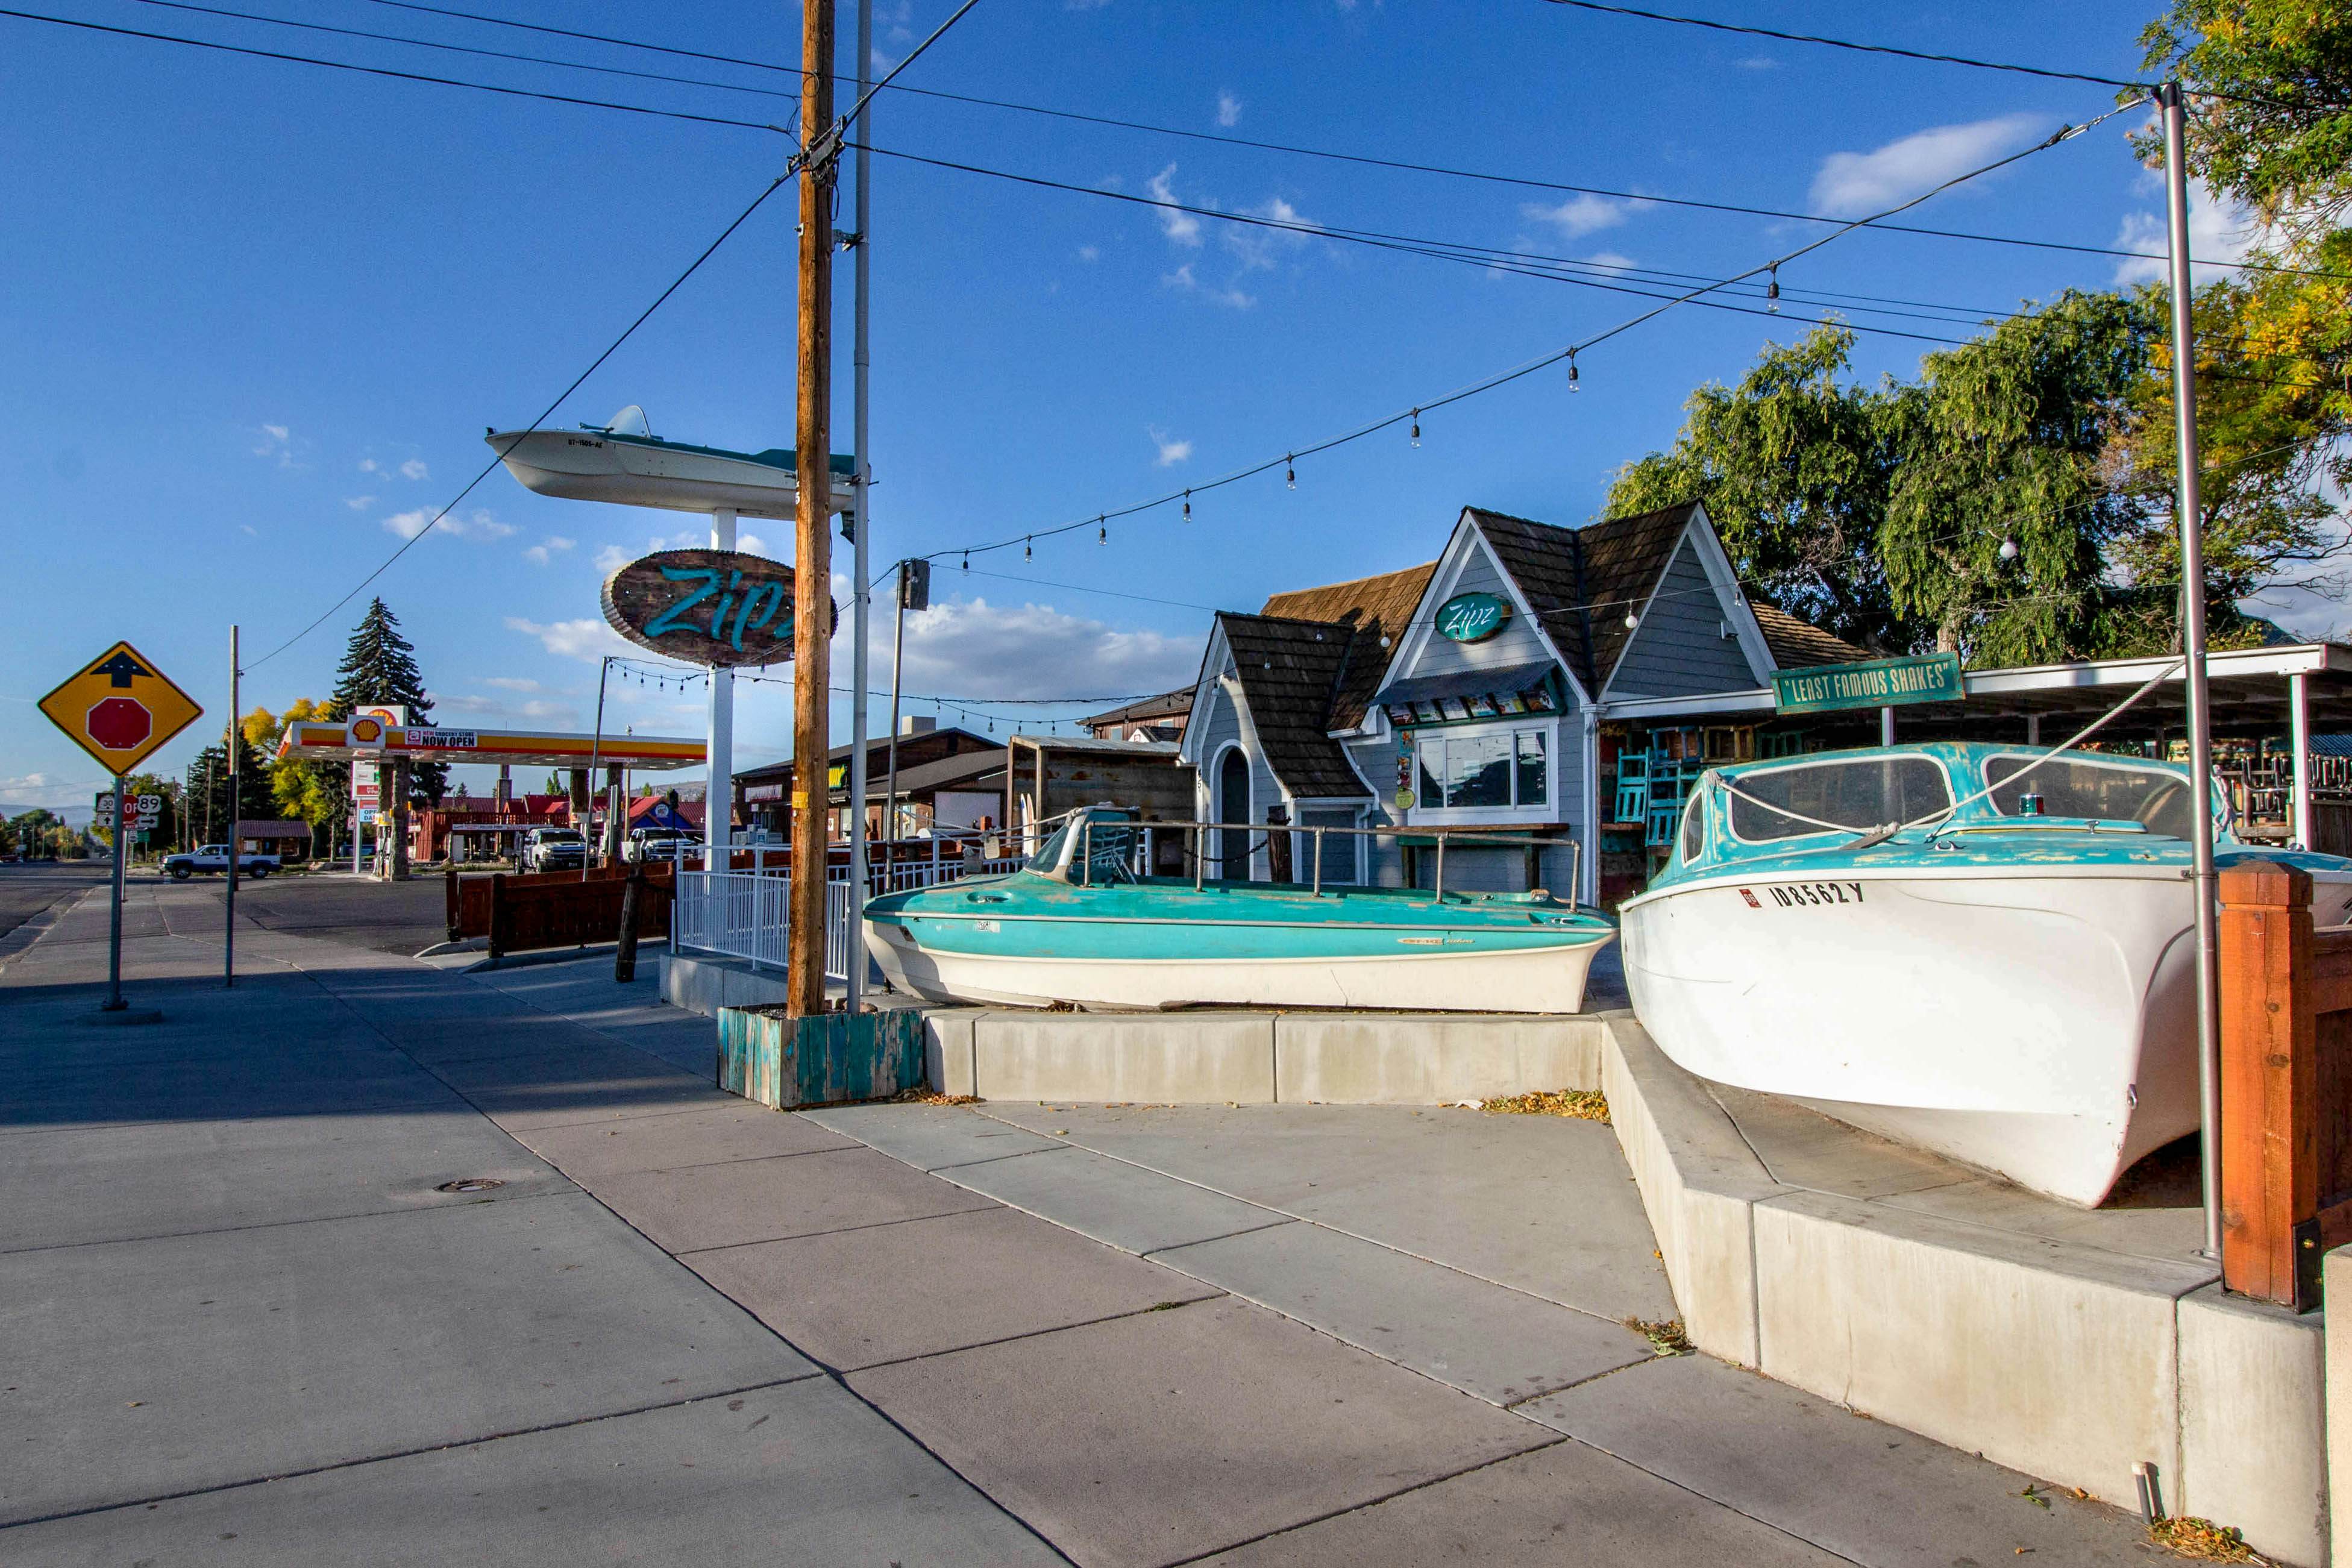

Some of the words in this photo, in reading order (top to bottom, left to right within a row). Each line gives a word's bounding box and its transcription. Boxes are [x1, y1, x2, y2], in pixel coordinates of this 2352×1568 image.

[642, 565, 794, 653] Zip
[1444, 603, 1495, 635] Zipz
[1834, 670, 1888, 698] FAMOUS
[422, 736, 447, 747] NOW
[450, 736, 475, 747] OPEN
[140, 798, 158, 809] 89
